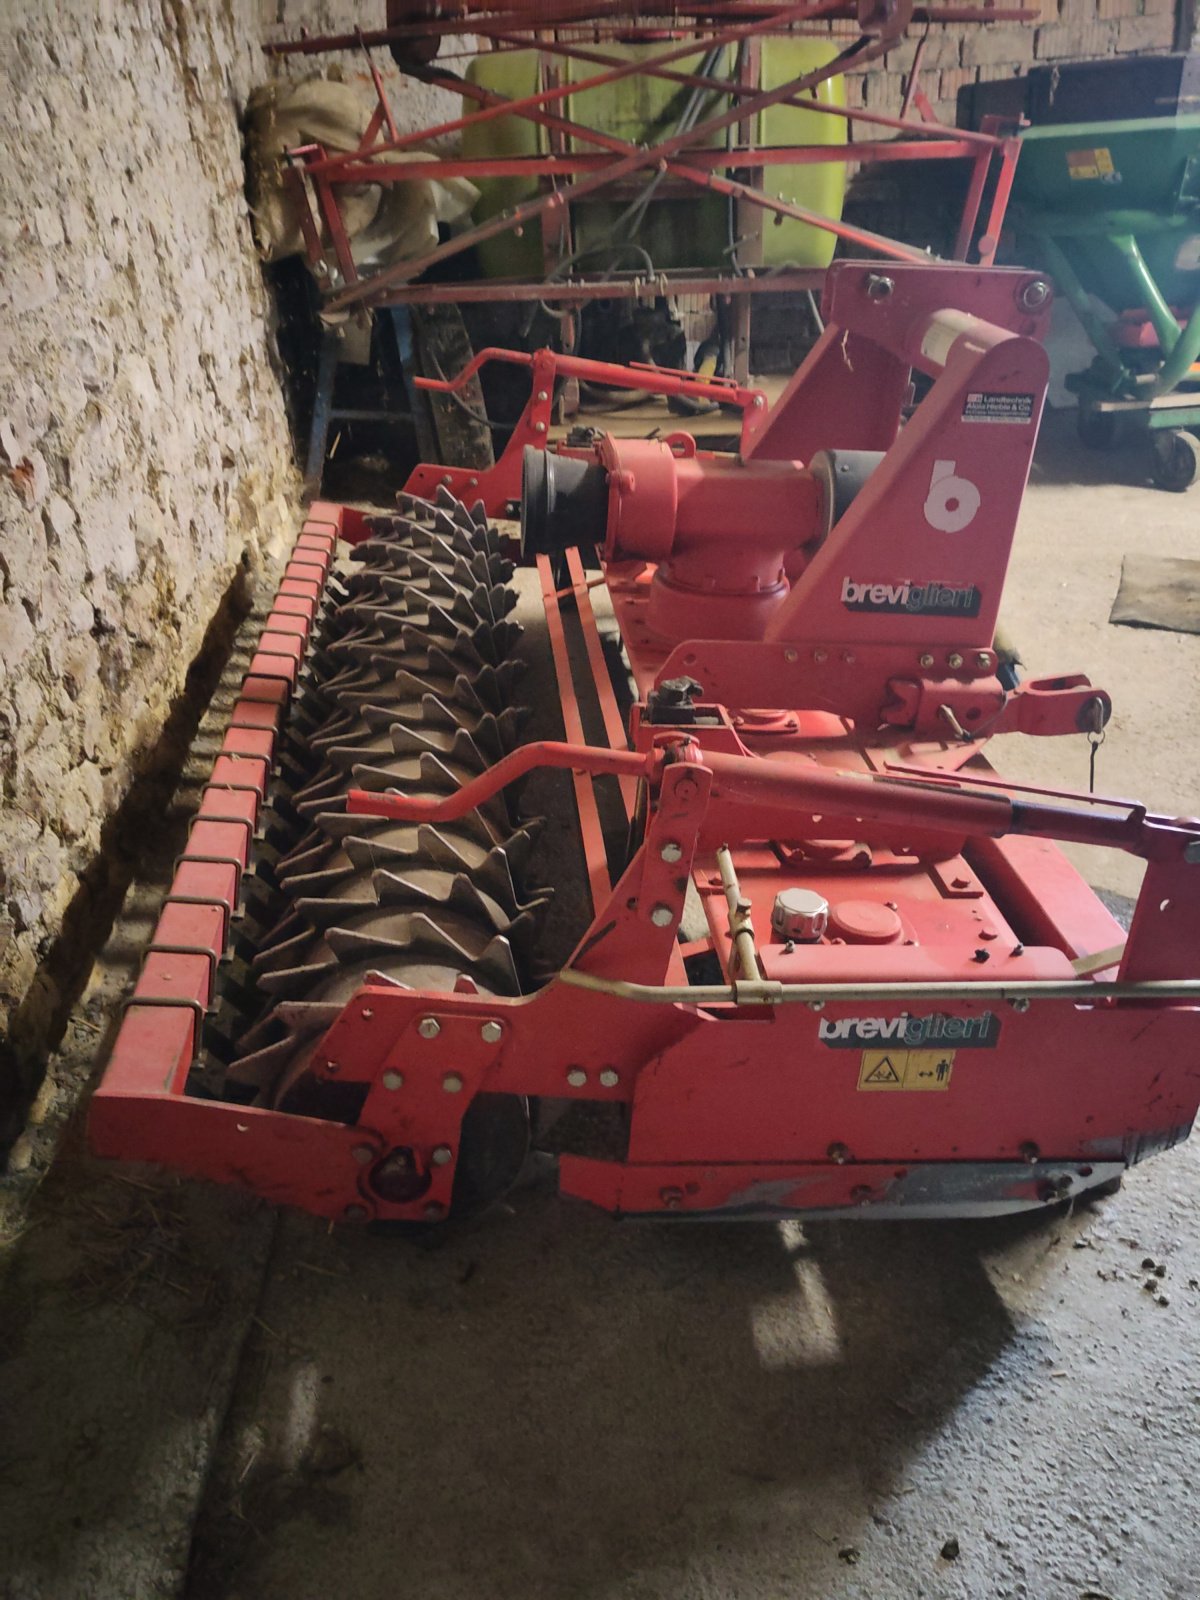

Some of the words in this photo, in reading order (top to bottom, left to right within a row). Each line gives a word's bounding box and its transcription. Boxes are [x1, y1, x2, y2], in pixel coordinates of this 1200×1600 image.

[984, 396, 1032, 404] Landtechnik
[841, 576, 975, 611] breviglieri
[818, 1010, 992, 1046] breviglieri
